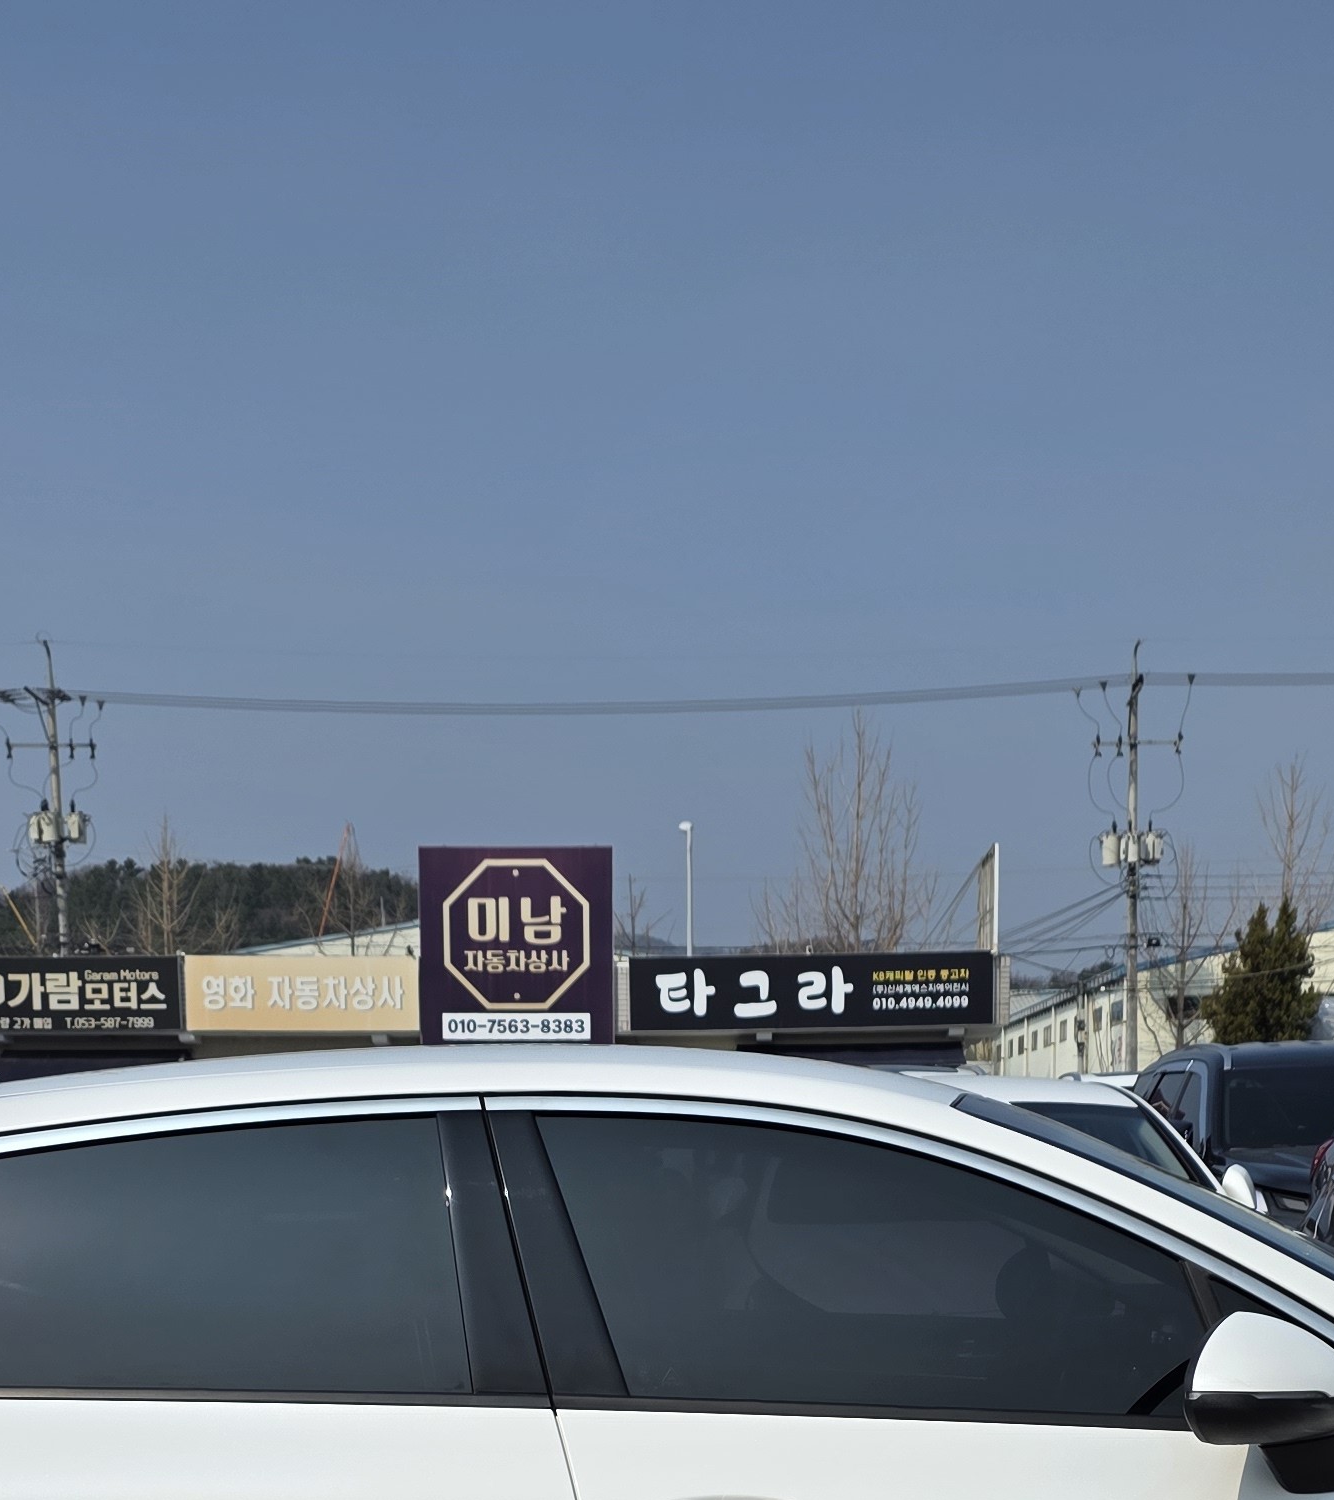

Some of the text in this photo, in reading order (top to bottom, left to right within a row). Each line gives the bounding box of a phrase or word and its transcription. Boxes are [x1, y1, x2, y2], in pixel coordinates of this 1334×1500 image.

[467, 895, 568, 946] 미남
[84, 969, 159, 981] Garam Motors
[463, 949, 571, 974] 자동차상사
[6, 971, 168, 1011] 가람 모터스
[201, 974, 405, 1012] 영화 자동차상사
[653, 965, 855, 1019] 타그라
[64, 1016, 155, 1030] T.053-587-7999
[447, 1018, 586, 1034] 010-7563-8383
